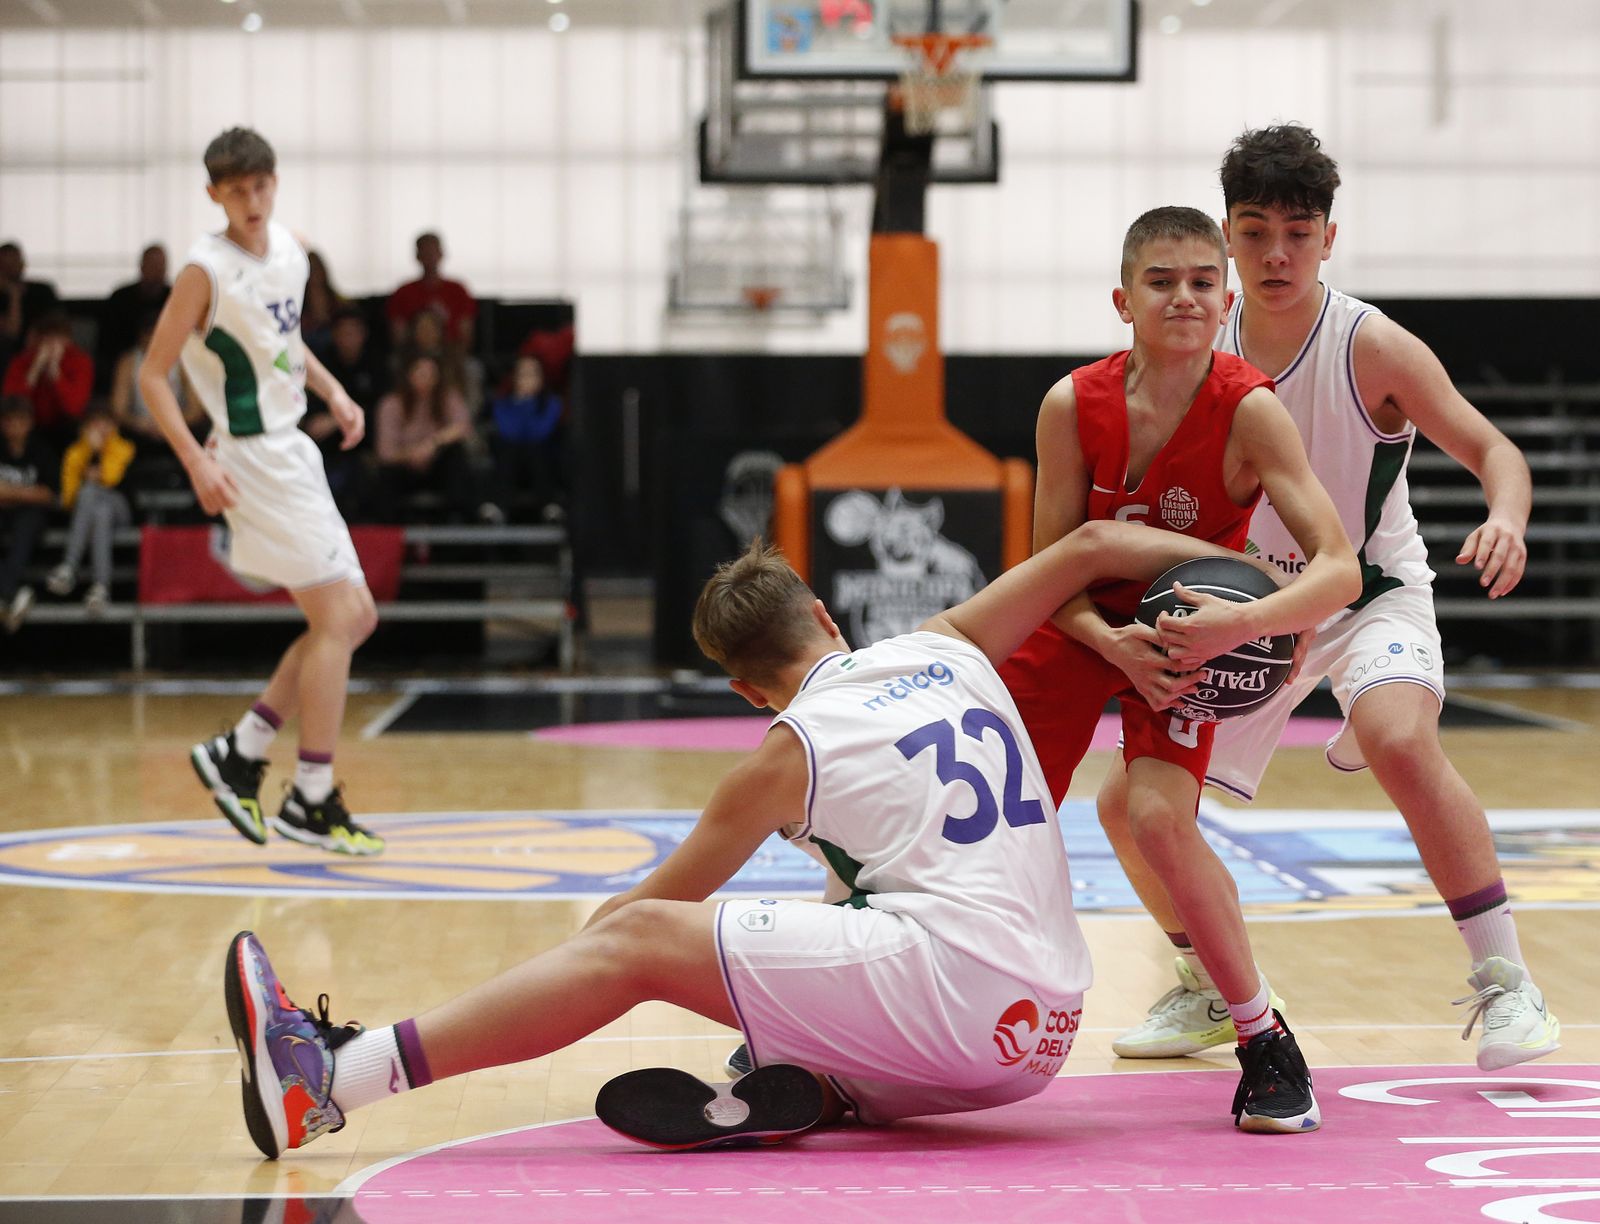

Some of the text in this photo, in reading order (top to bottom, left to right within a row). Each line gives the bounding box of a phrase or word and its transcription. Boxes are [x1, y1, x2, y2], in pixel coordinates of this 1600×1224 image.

[266, 299, 300, 334] 38
[1161, 509, 1198, 521] GIRONA
[1163, 499, 1195, 511] BASQUET
[862, 660, 956, 711] málag
[894, 707, 1047, 845] 32
[1045, 1008, 1082, 1034] COST
[1035, 1037, 1064, 1057] DEL
[1022, 1058, 1063, 1077] MÁL
